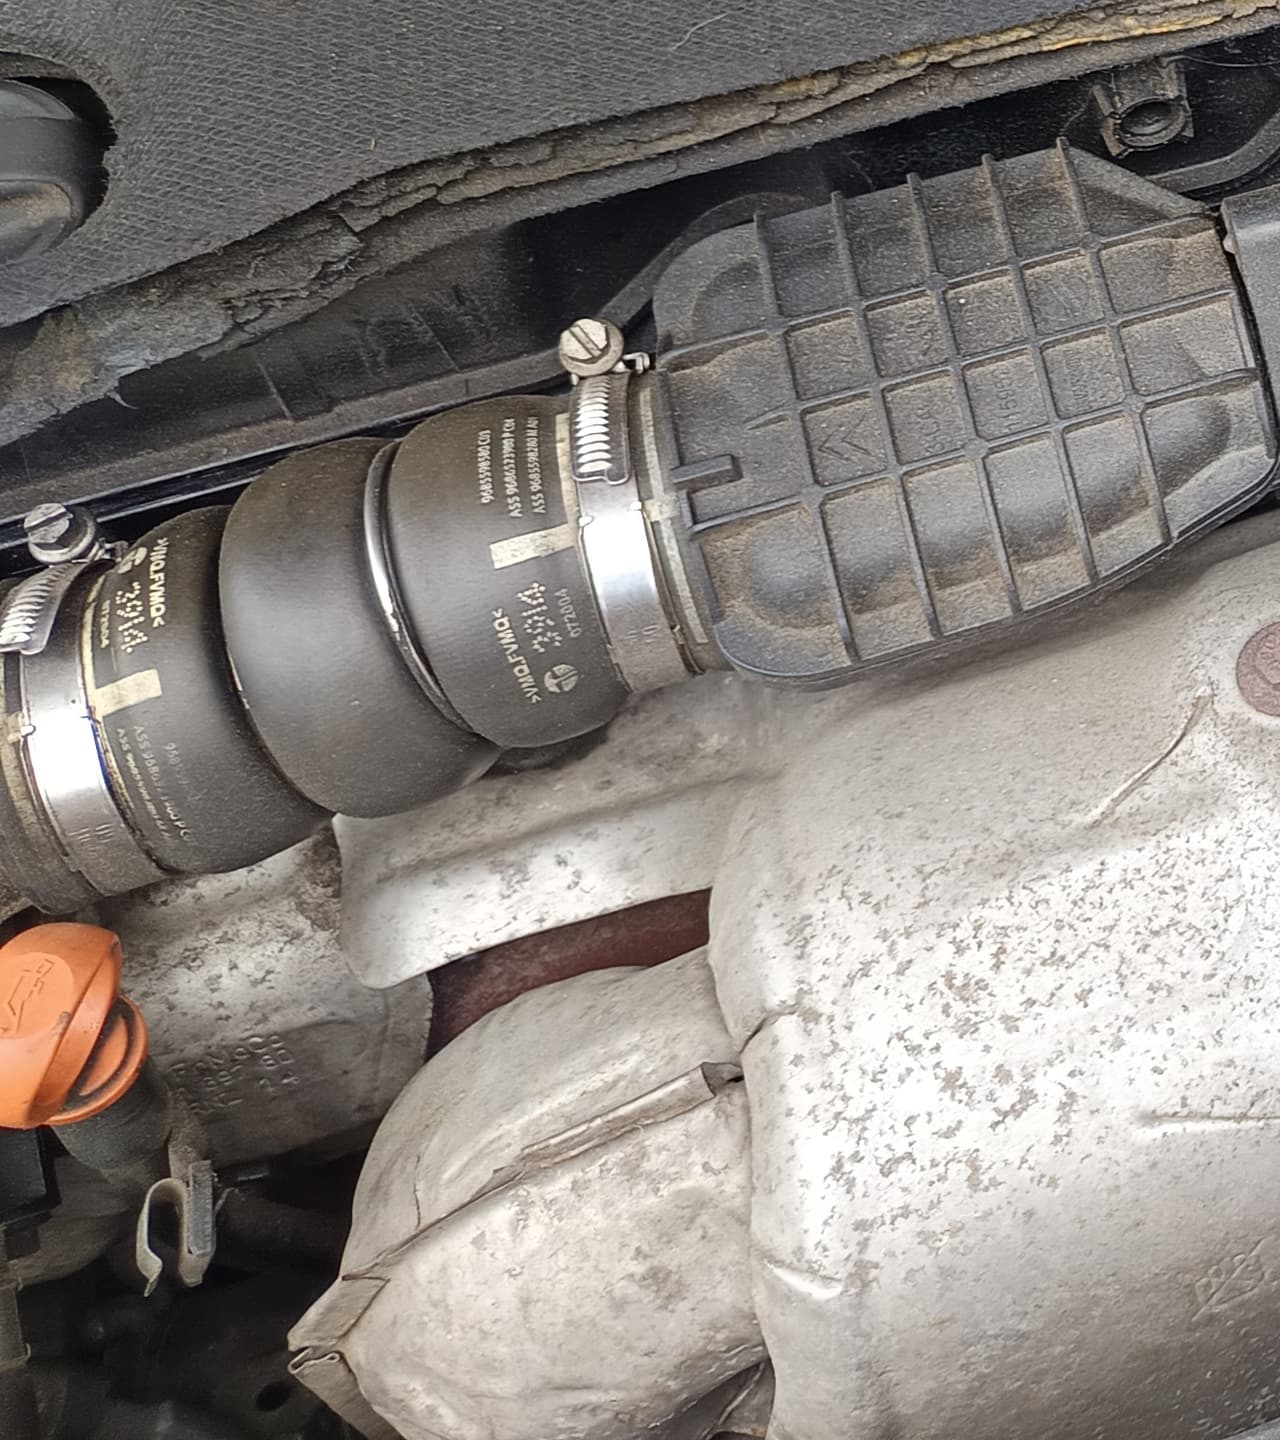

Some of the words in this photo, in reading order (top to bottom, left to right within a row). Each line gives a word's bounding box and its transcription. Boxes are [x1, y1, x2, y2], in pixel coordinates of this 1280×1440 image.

[507, 495, 523, 517] ASS
[531, 492, 547, 513] ASS
[554, 588, 582, 638] 072004
[133, 725, 152, 749] ASS
